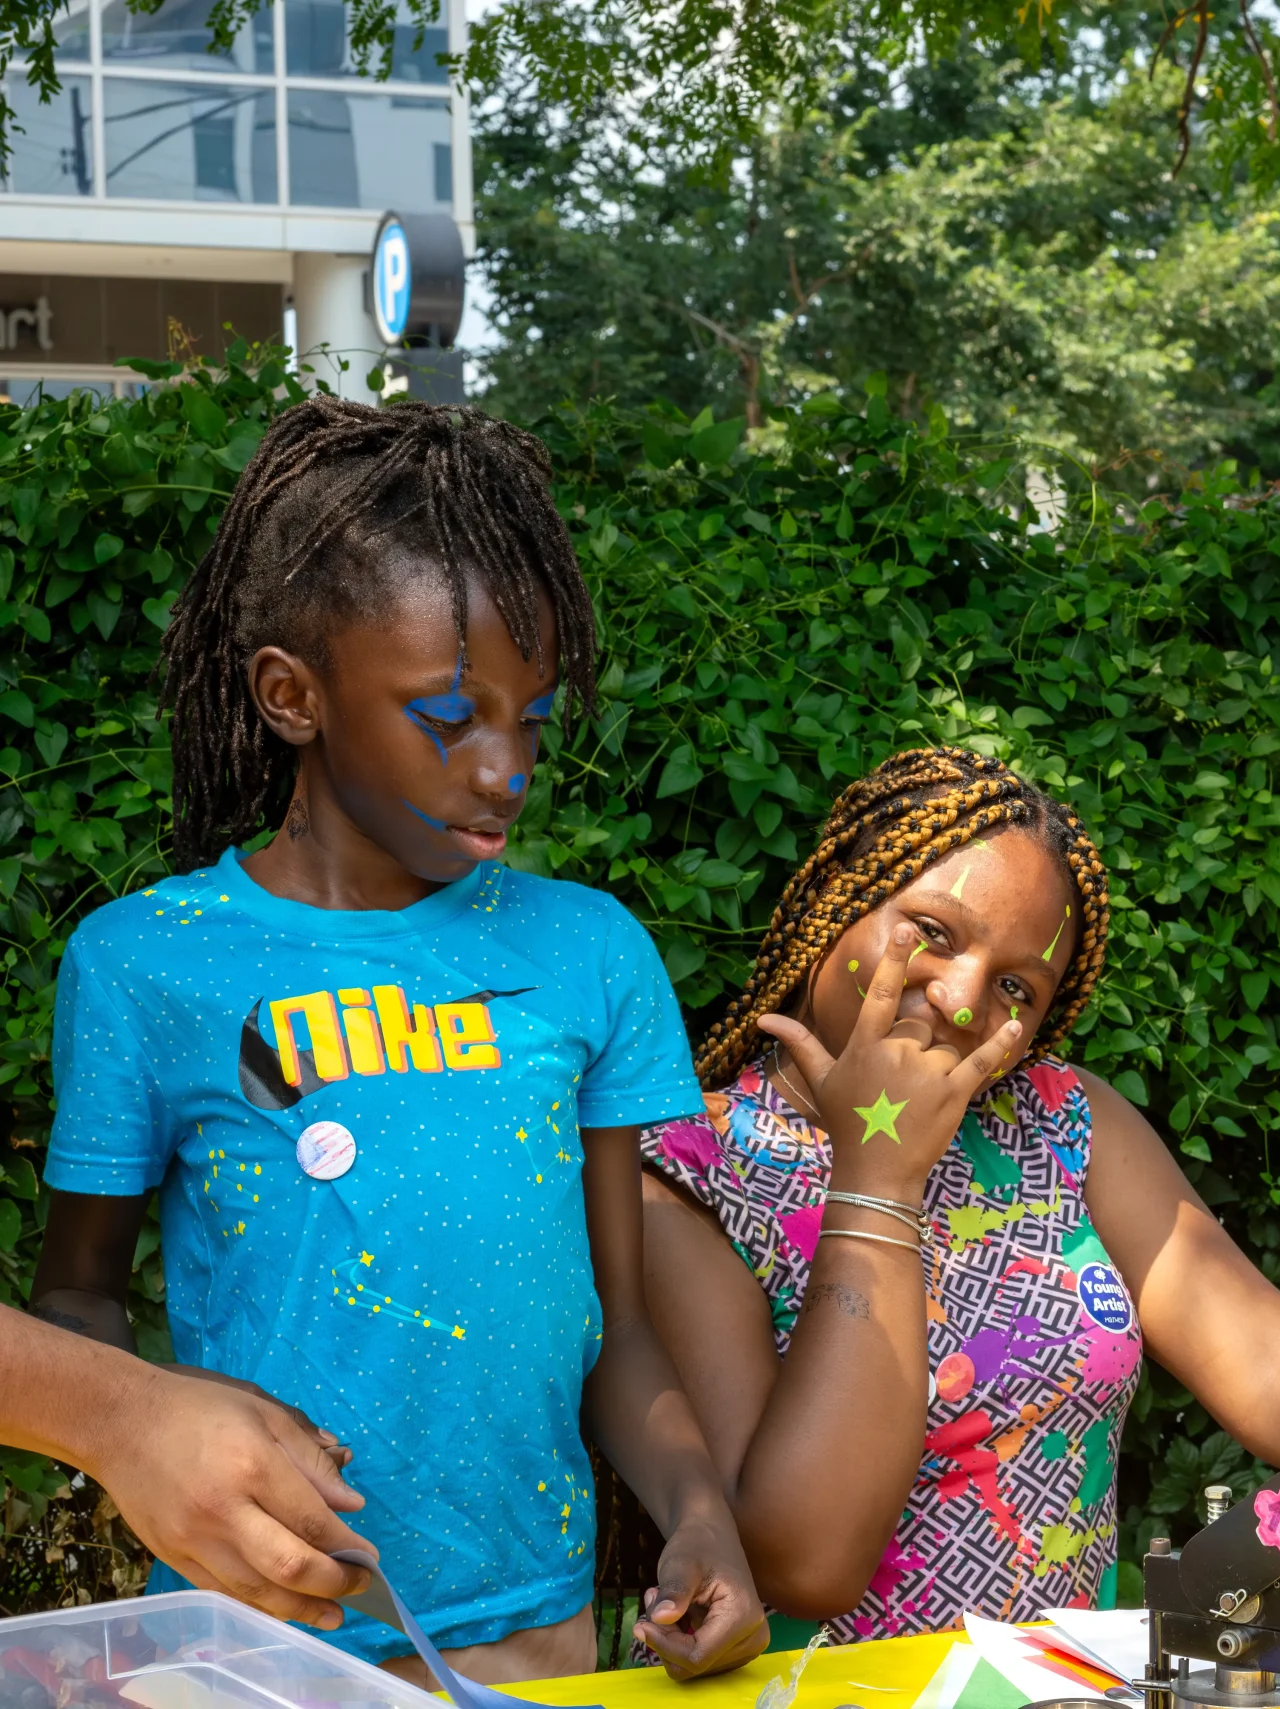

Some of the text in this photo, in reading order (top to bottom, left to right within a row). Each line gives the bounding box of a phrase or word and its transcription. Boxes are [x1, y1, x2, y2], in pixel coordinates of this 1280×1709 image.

[384, 237, 408, 322] P
[1082, 1281, 1123, 1298] Young
[1093, 1297, 1127, 1312] Artist
